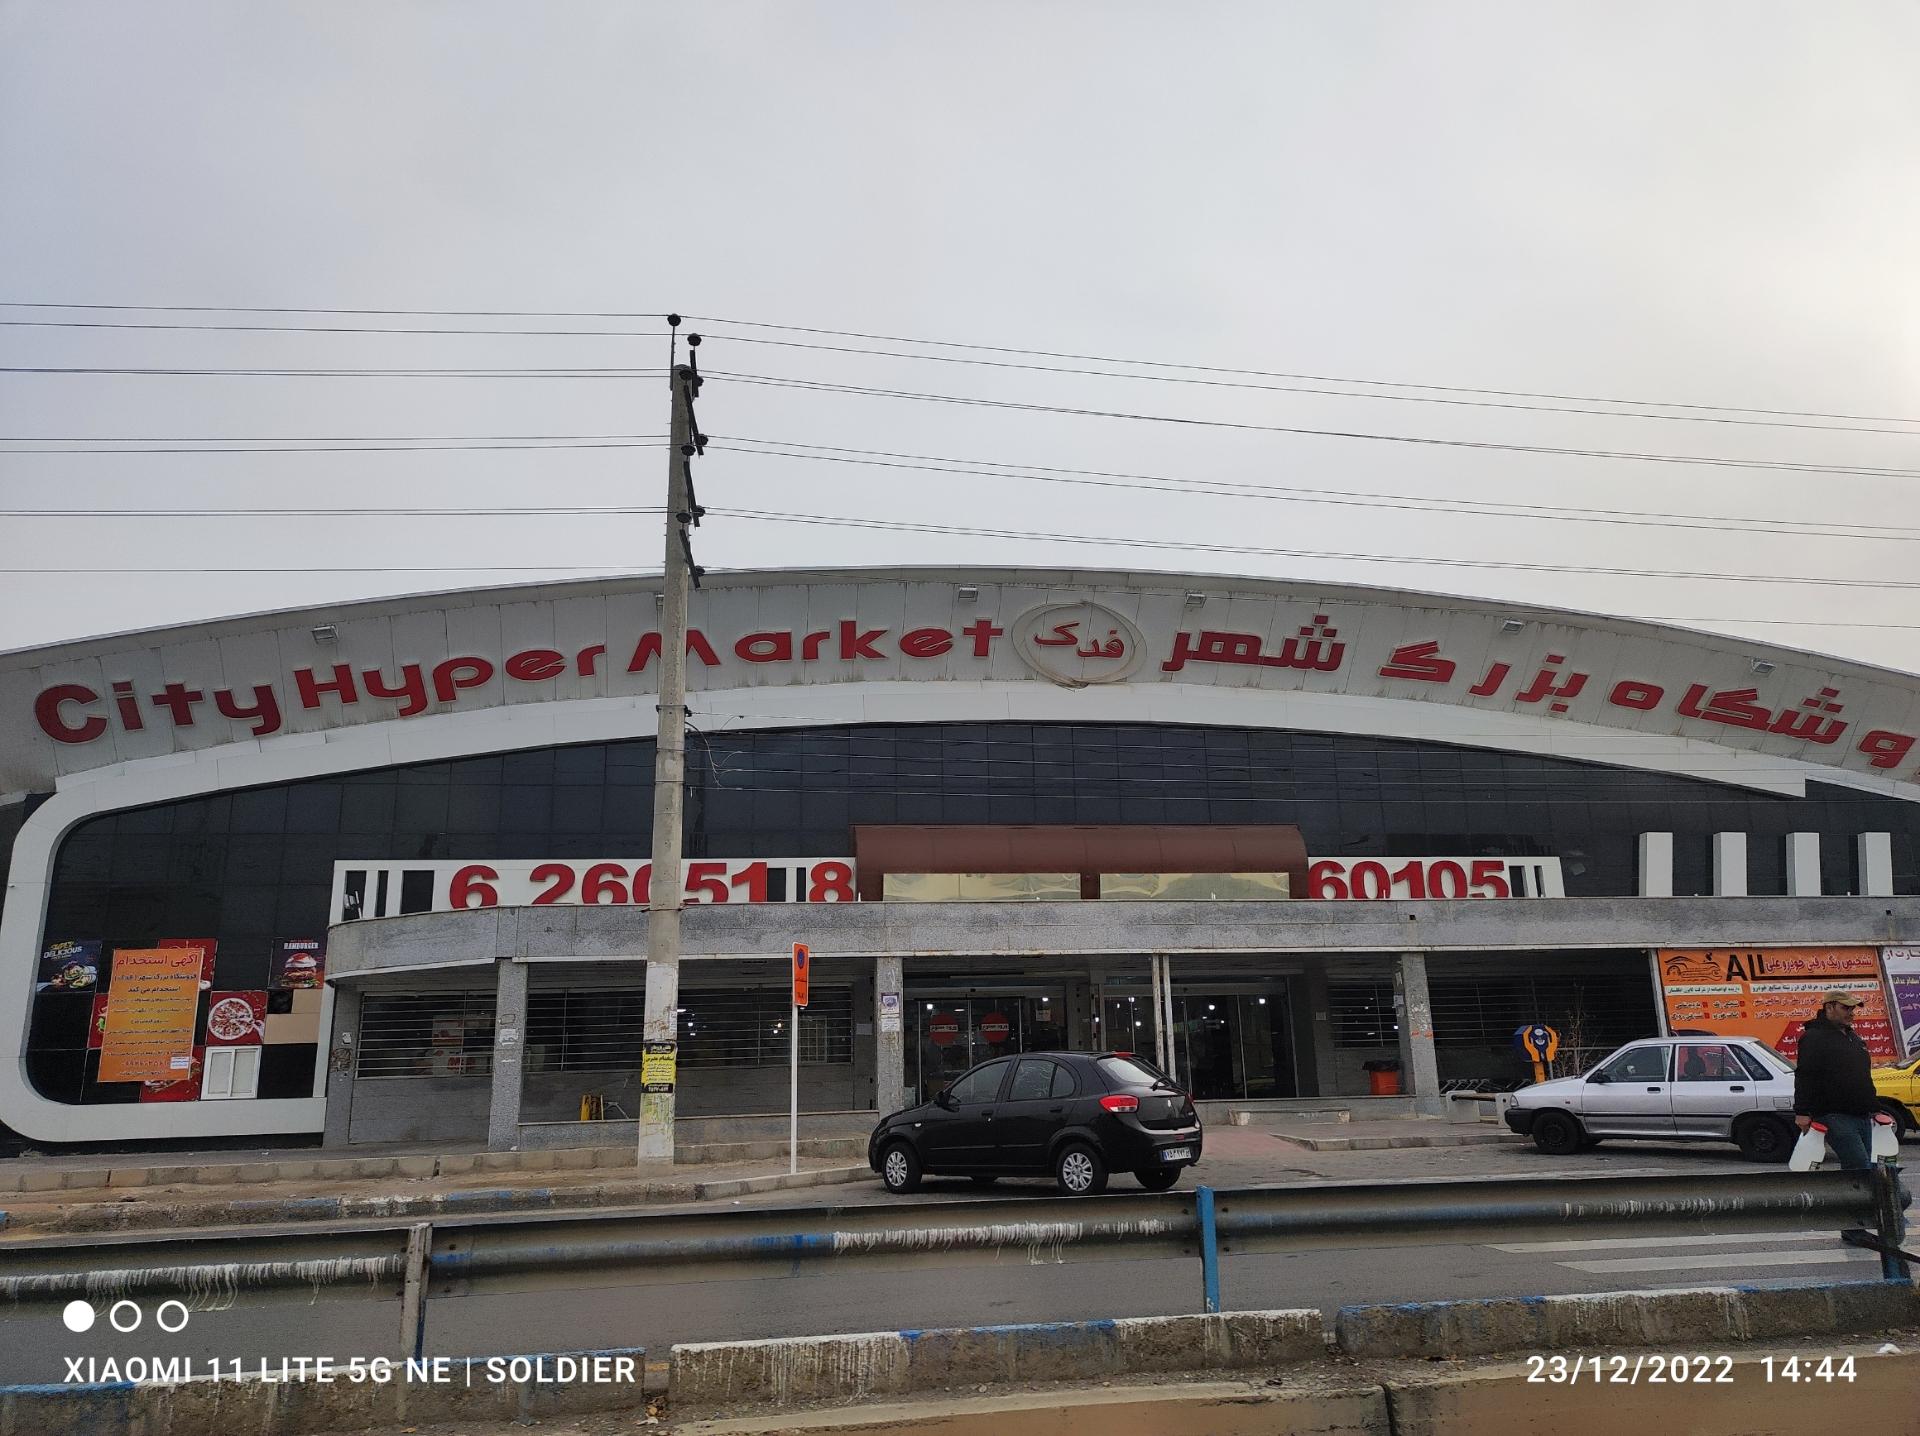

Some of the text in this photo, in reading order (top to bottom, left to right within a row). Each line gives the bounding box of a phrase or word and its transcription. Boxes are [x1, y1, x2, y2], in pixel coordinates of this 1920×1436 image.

[1033, 621, 1126, 660] فدک
[34, 619, 1004, 745] City Hyper Market
[1160, 614, 1916, 769] وشگاه بزرگ شهر
[1308, 859, 1510, 900] 60105
[43, 946, 82, 959] DELICIOUS
[116, 954, 168, 969] استخدام
[1842, 954, 1873, 969] تشخیص
[1726, 953, 1765, 981] ALI
[1766, 957, 1783, 973] علی
[1782, 957, 1806, 973] خودرو
